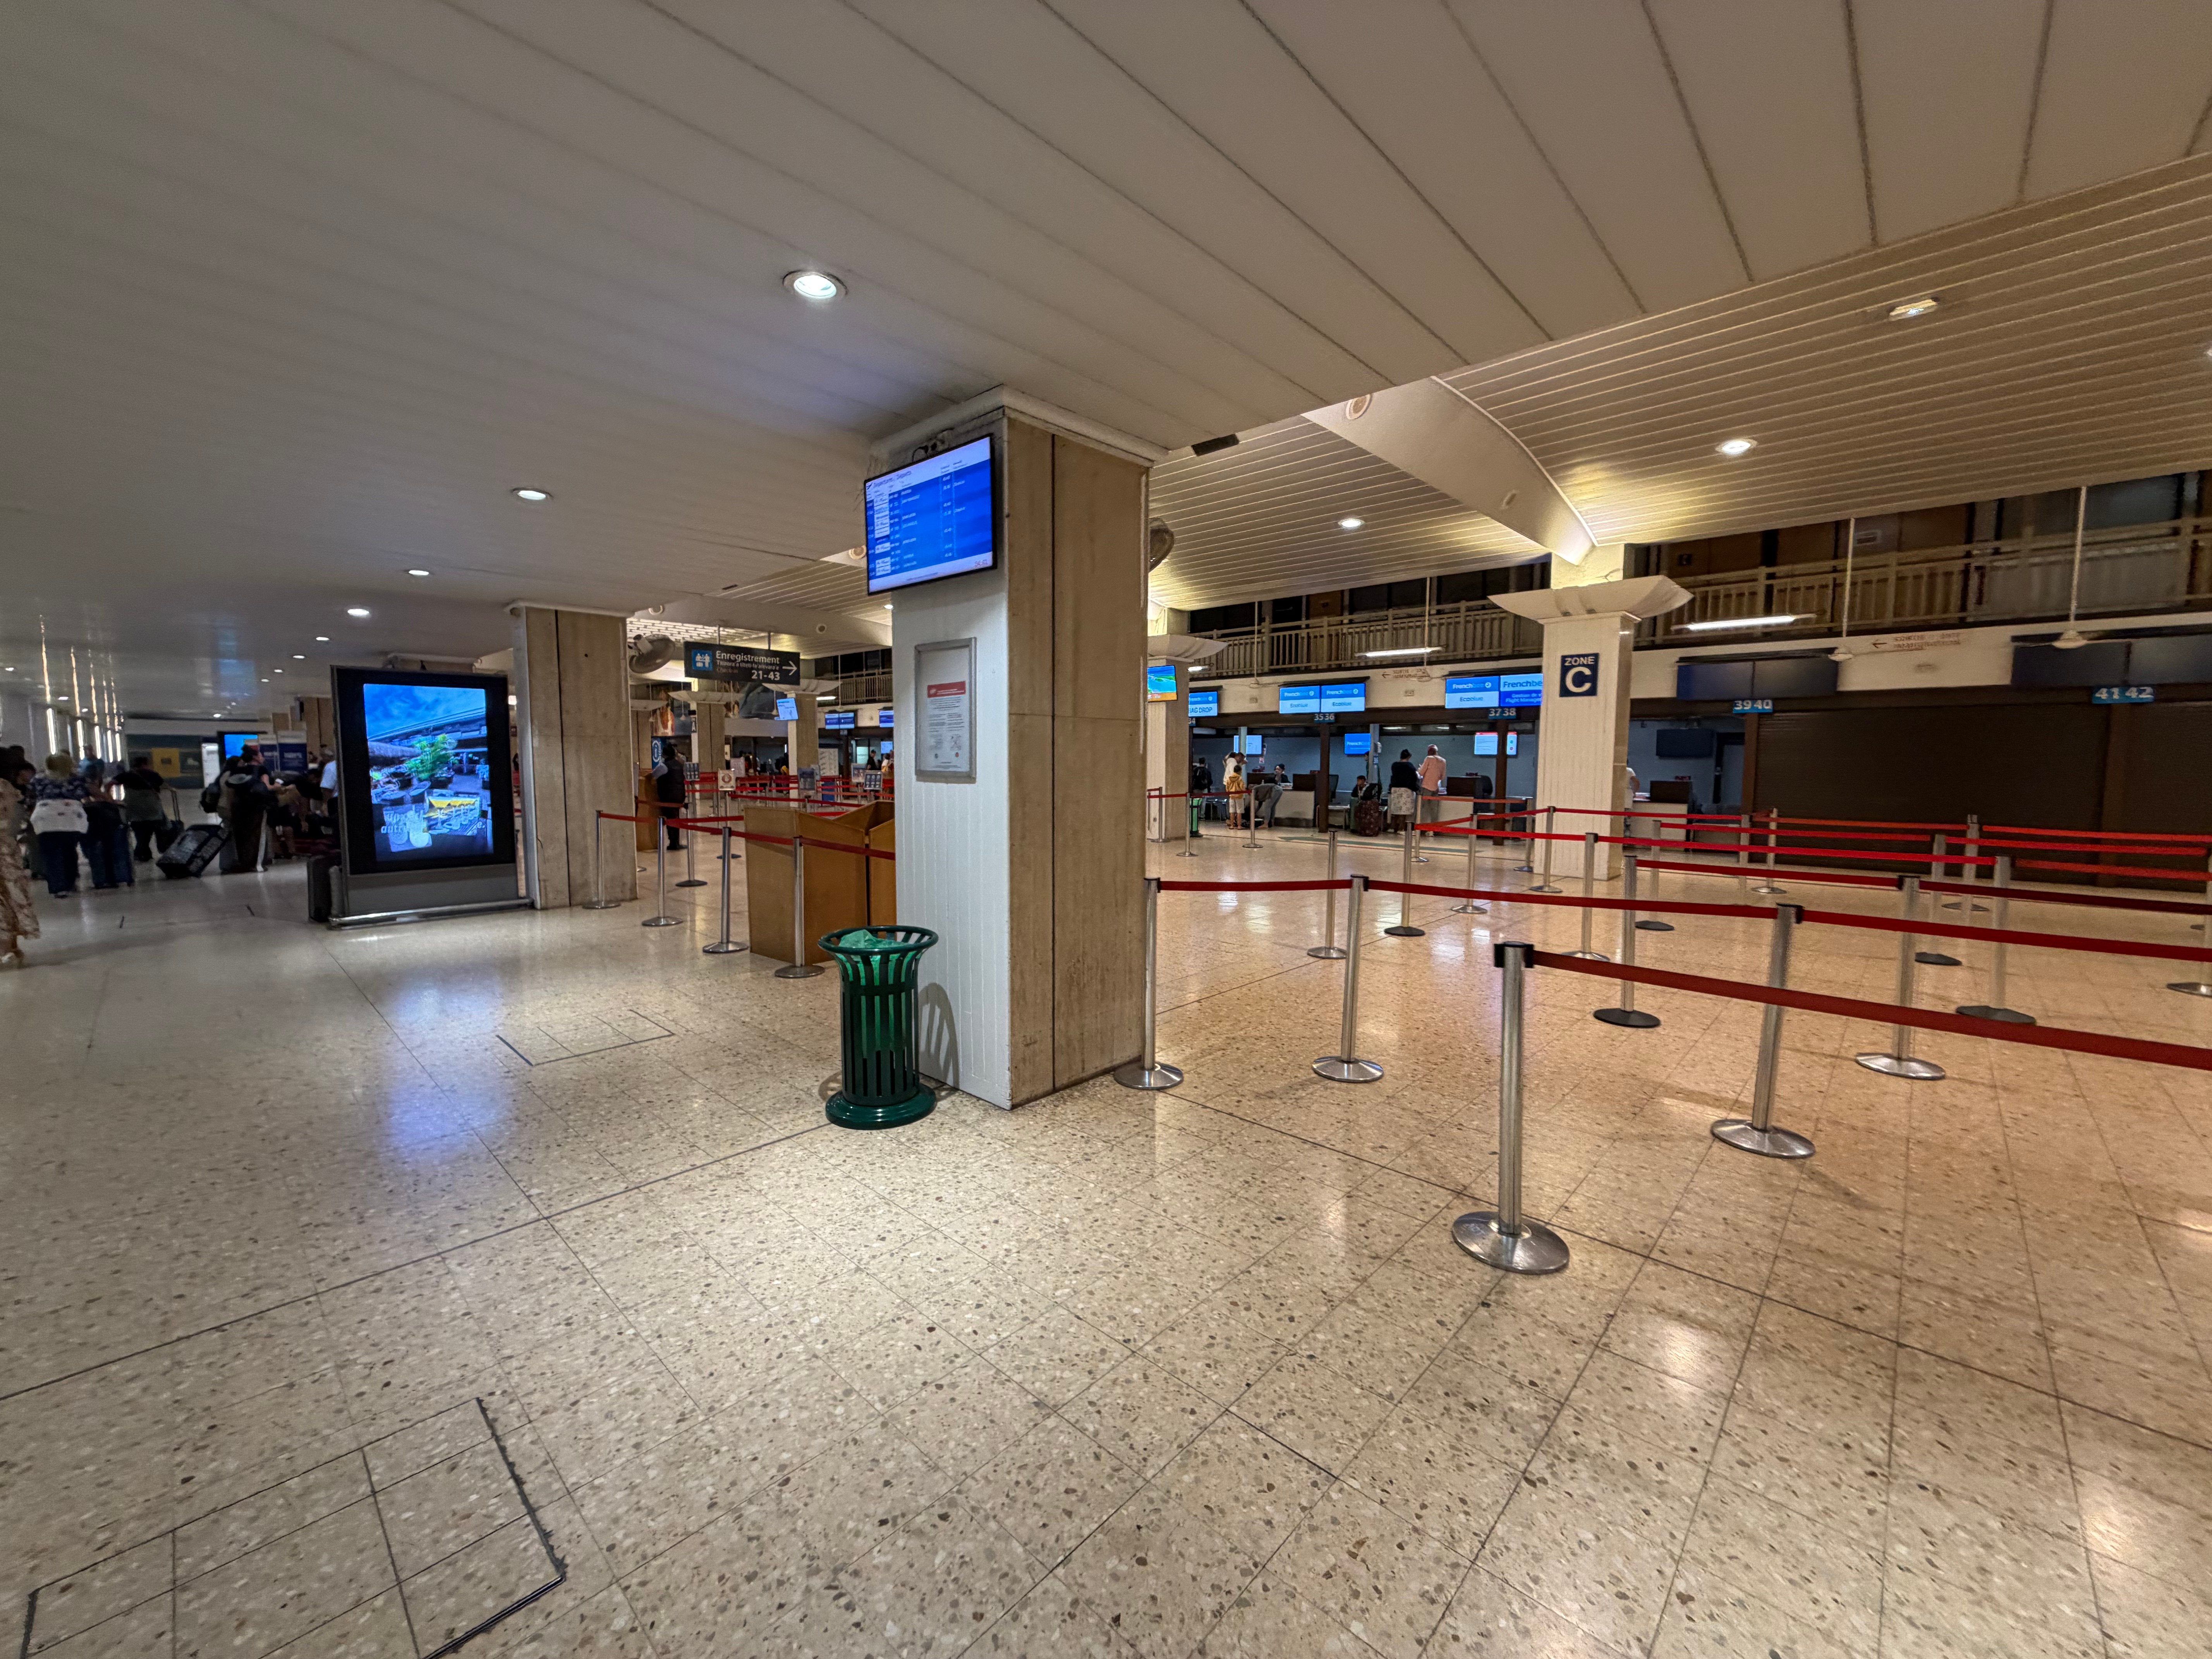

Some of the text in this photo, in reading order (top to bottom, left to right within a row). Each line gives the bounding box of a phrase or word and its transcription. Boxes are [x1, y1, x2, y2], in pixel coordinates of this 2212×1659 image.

[716, 651, 780, 664] Enregistrement
[1564, 656, 1595, 666] ZONE
[752, 670, 780, 680] 21-43
[1566, 666, 1592, 693] C
[2095, 687, 2154, 699] 41 42
[1734, 699, 1772, 709] 39 40
[1503, 708, 1516, 716] 38
